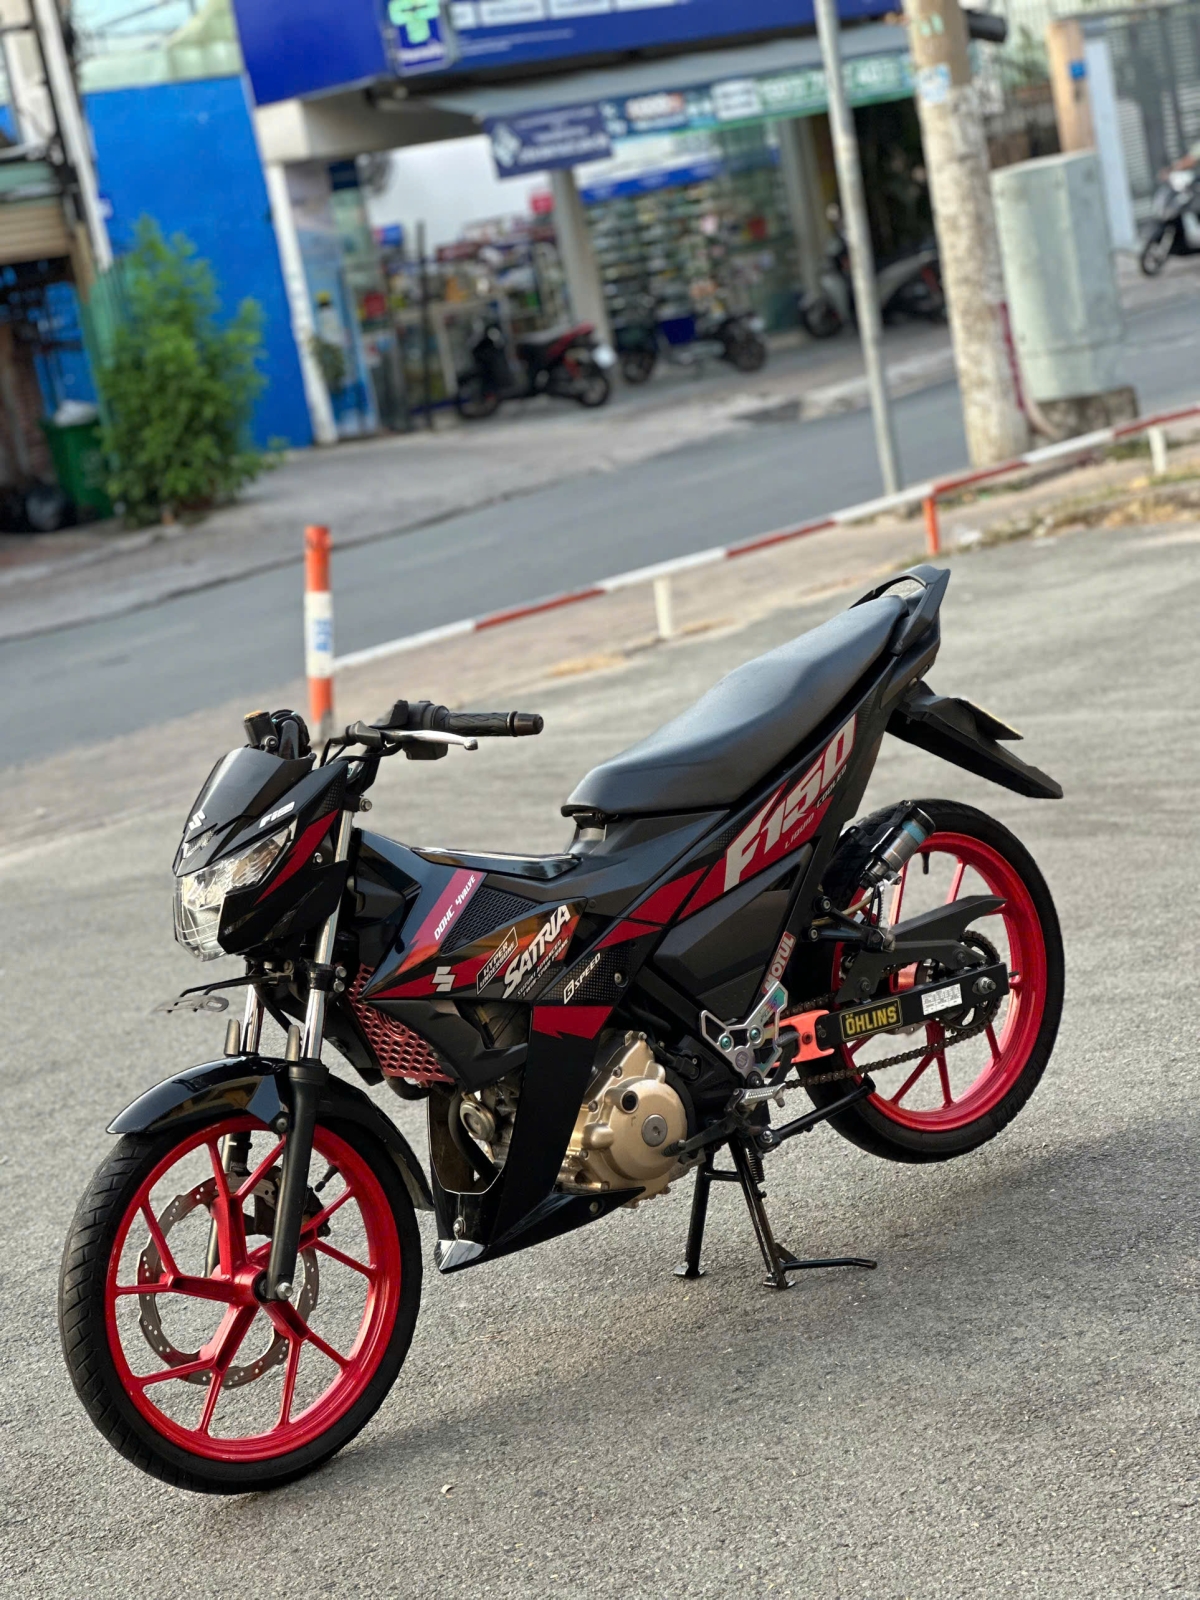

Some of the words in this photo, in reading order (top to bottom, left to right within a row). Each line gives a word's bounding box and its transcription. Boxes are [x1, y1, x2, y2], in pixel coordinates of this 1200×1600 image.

[724, 713, 856, 893] F150
[434, 904, 455, 940] DOHC
[455, 874, 476, 905] 4VALVE
[483, 941, 508, 976] HYPER
[502, 904, 571, 999] SATRIA
[574, 952, 601, 988] SPEED
[764, 936, 794, 990] MOTUL
[845, 1006, 897, 1034] ÖHLINS
